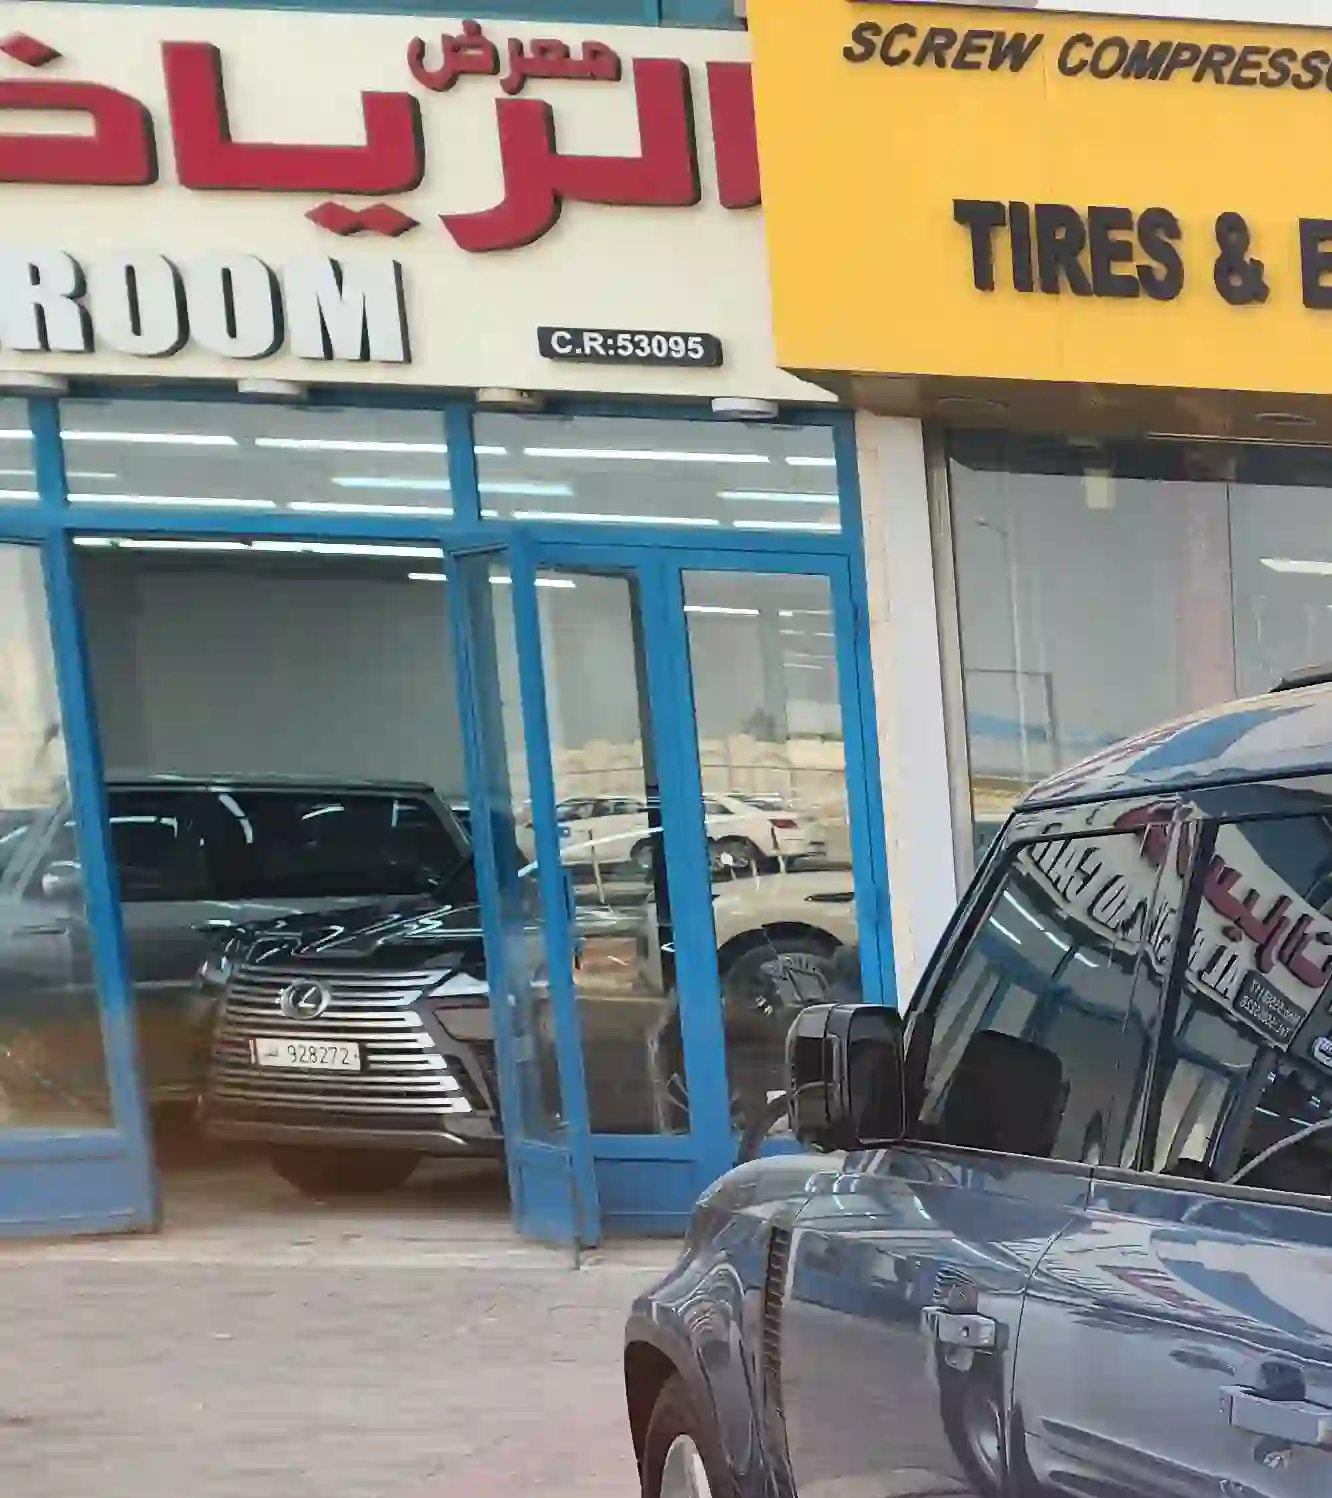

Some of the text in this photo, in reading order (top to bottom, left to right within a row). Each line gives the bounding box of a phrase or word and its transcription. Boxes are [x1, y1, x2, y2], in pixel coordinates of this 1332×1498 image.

[406, 19, 622, 95] معرض
[843, 20, 1043, 72] SCREW
[953, 199, 1184, 302] TIRES
[1213, 211, 1269, 305] &
[0, 248, 413, 364] ROOM
[551, 330, 705, 361] C.R:53095
[287, 1044, 350, 1065] 928272
